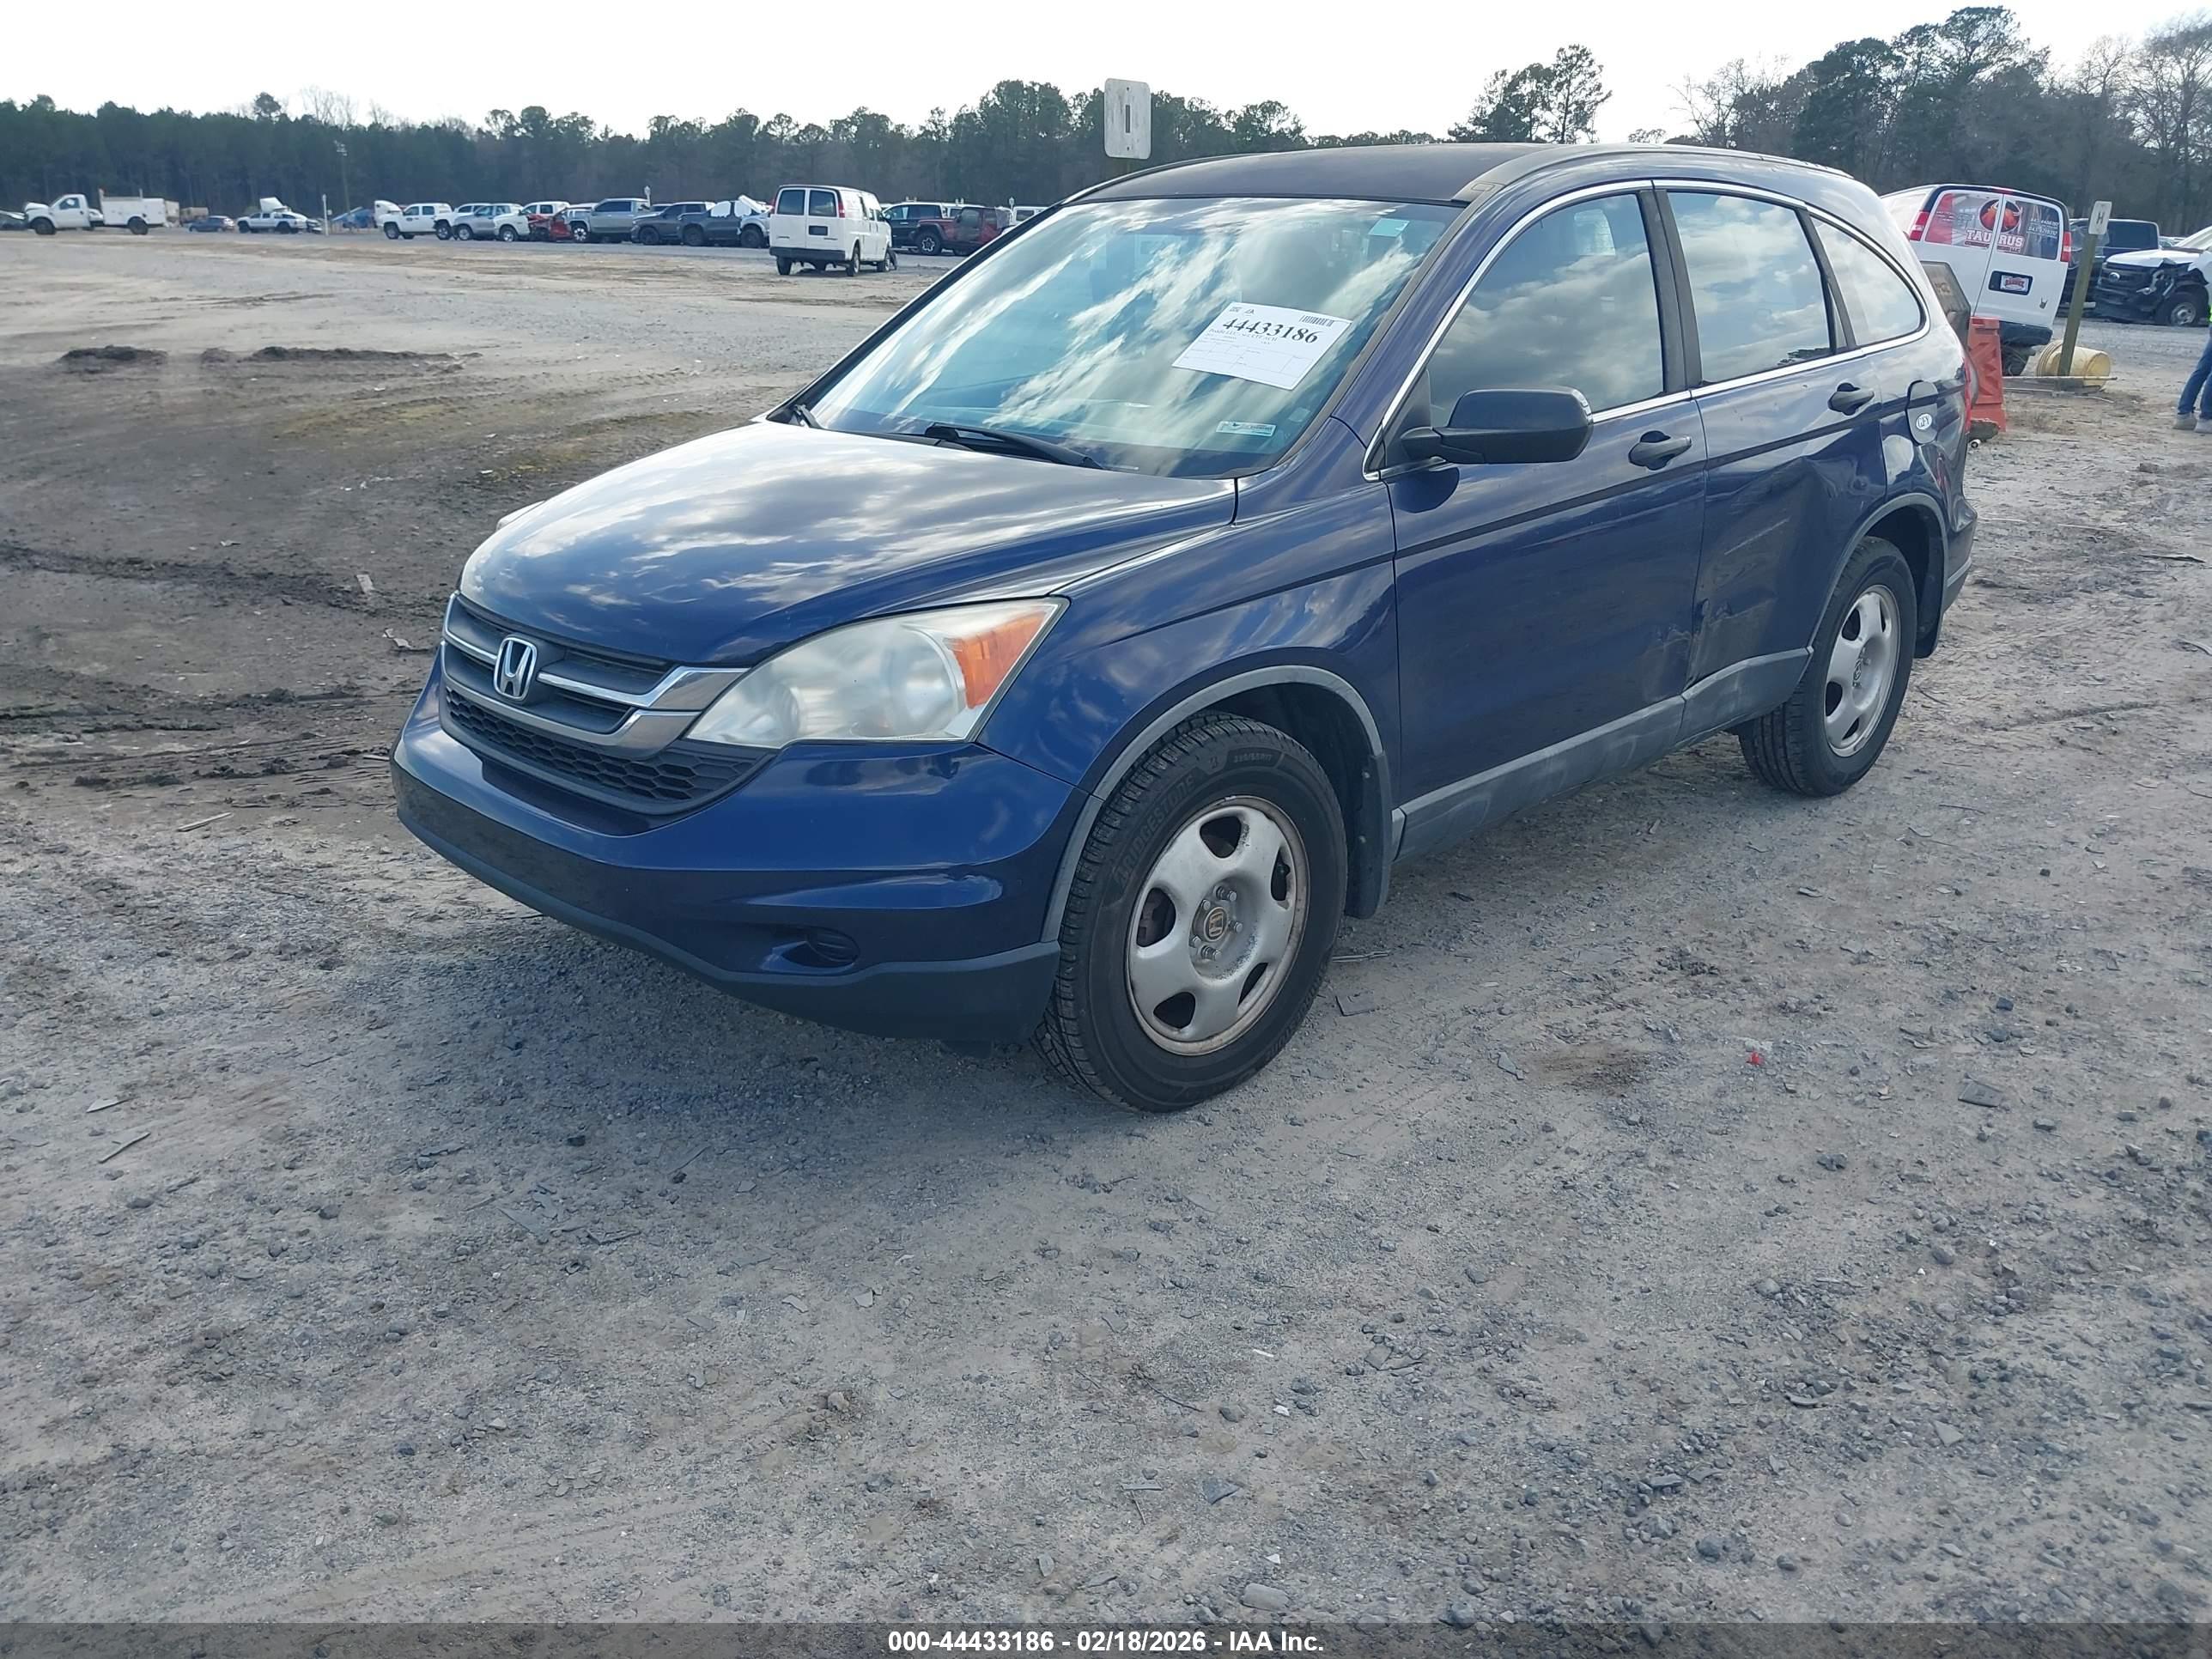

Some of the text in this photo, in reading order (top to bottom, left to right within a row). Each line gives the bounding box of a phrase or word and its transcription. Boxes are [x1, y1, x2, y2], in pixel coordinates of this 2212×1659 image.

[2096, 212, 2106, 225] H
[1966, 228, 2024, 248] TAURUS
[1222, 317, 1325, 343] 44433186
[1113, 773, 1195, 884] BRIDGESTONE
